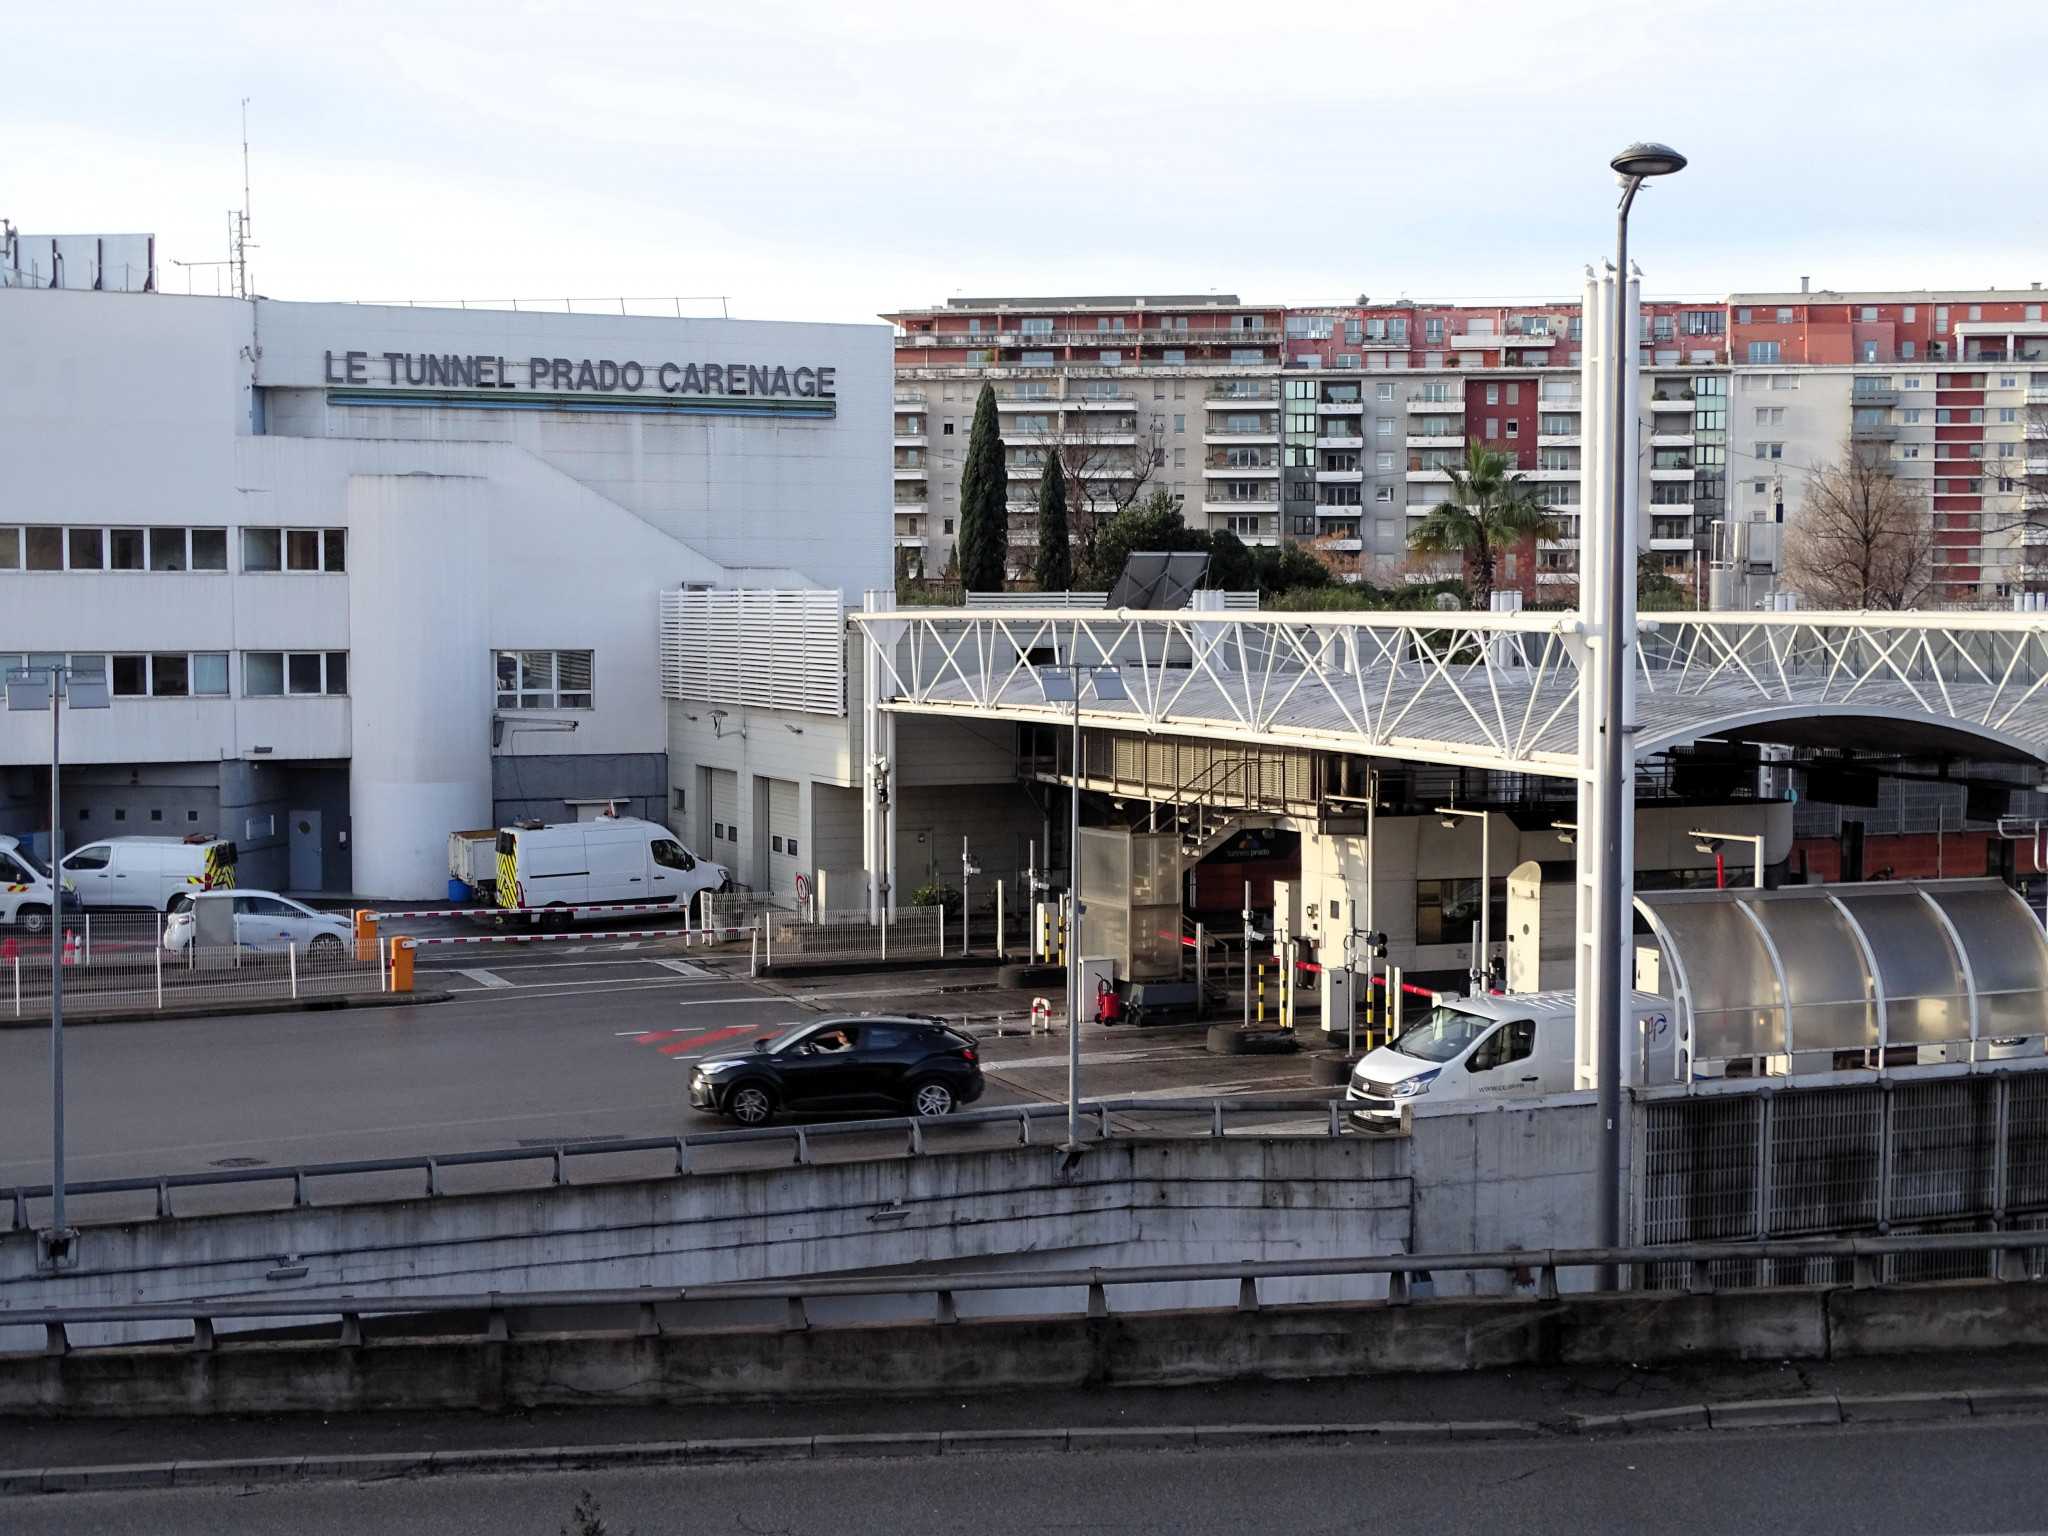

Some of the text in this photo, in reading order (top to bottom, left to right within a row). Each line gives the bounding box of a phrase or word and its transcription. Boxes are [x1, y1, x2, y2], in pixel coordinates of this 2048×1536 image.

[326, 351, 836, 398] LE TUNNEL PRADO CARENAGE
[1250, 849, 1270, 858] prado
